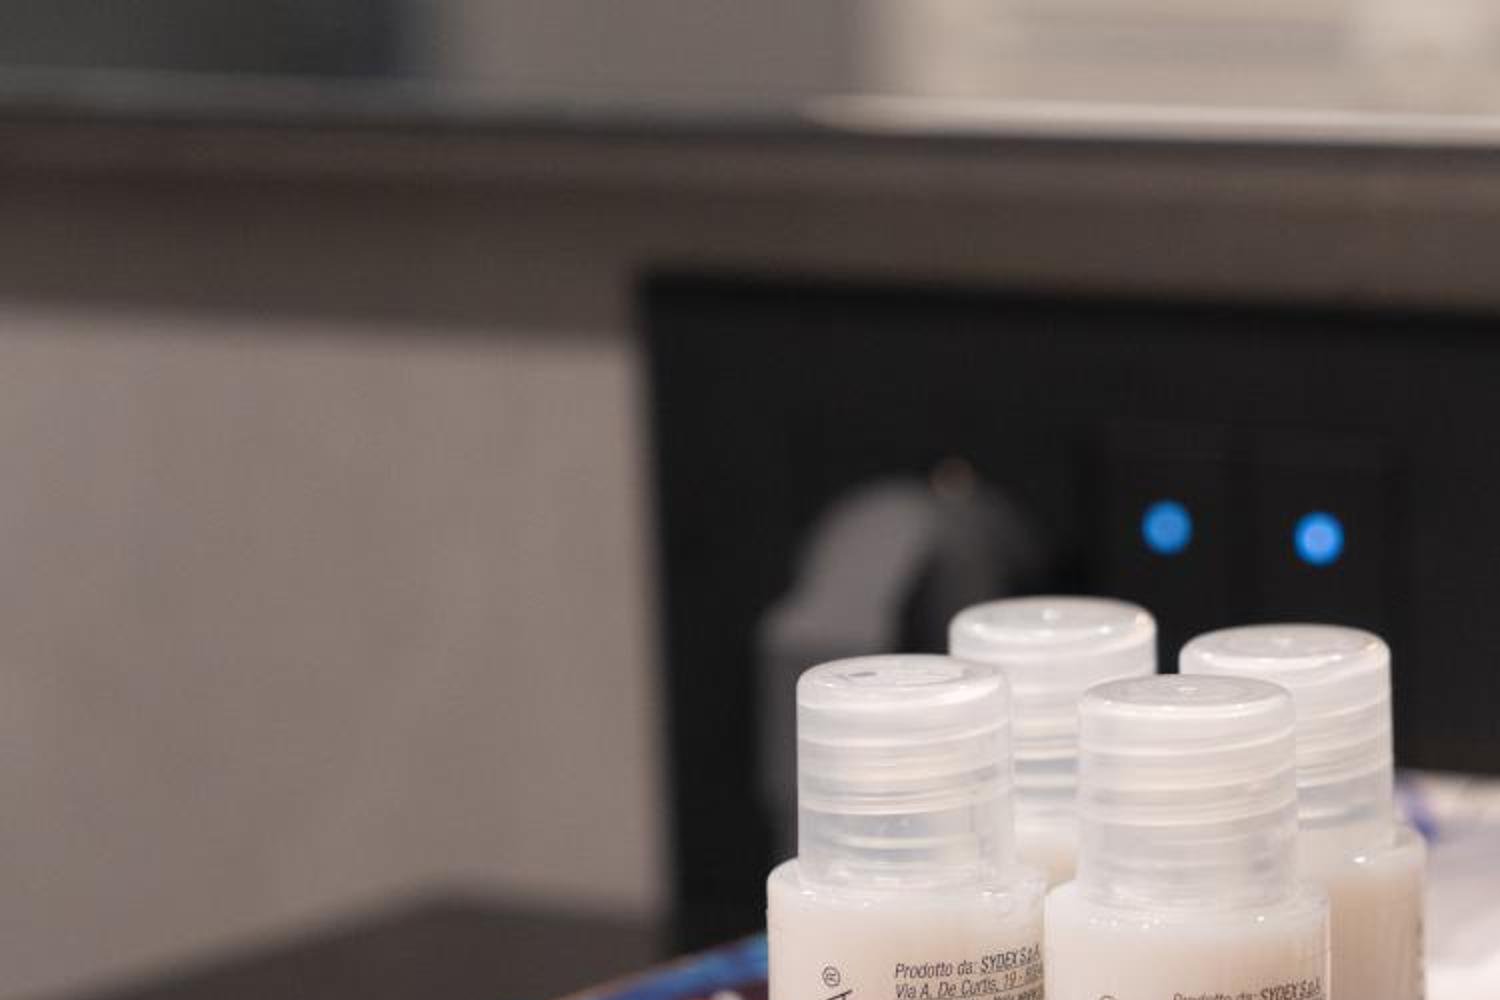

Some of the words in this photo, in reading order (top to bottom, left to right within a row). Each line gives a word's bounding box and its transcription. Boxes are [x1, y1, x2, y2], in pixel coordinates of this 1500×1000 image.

[895, 961, 953, 979] Prodotto
[895, 983, 917, 999] Via
[938, 981, 957, 997] De
